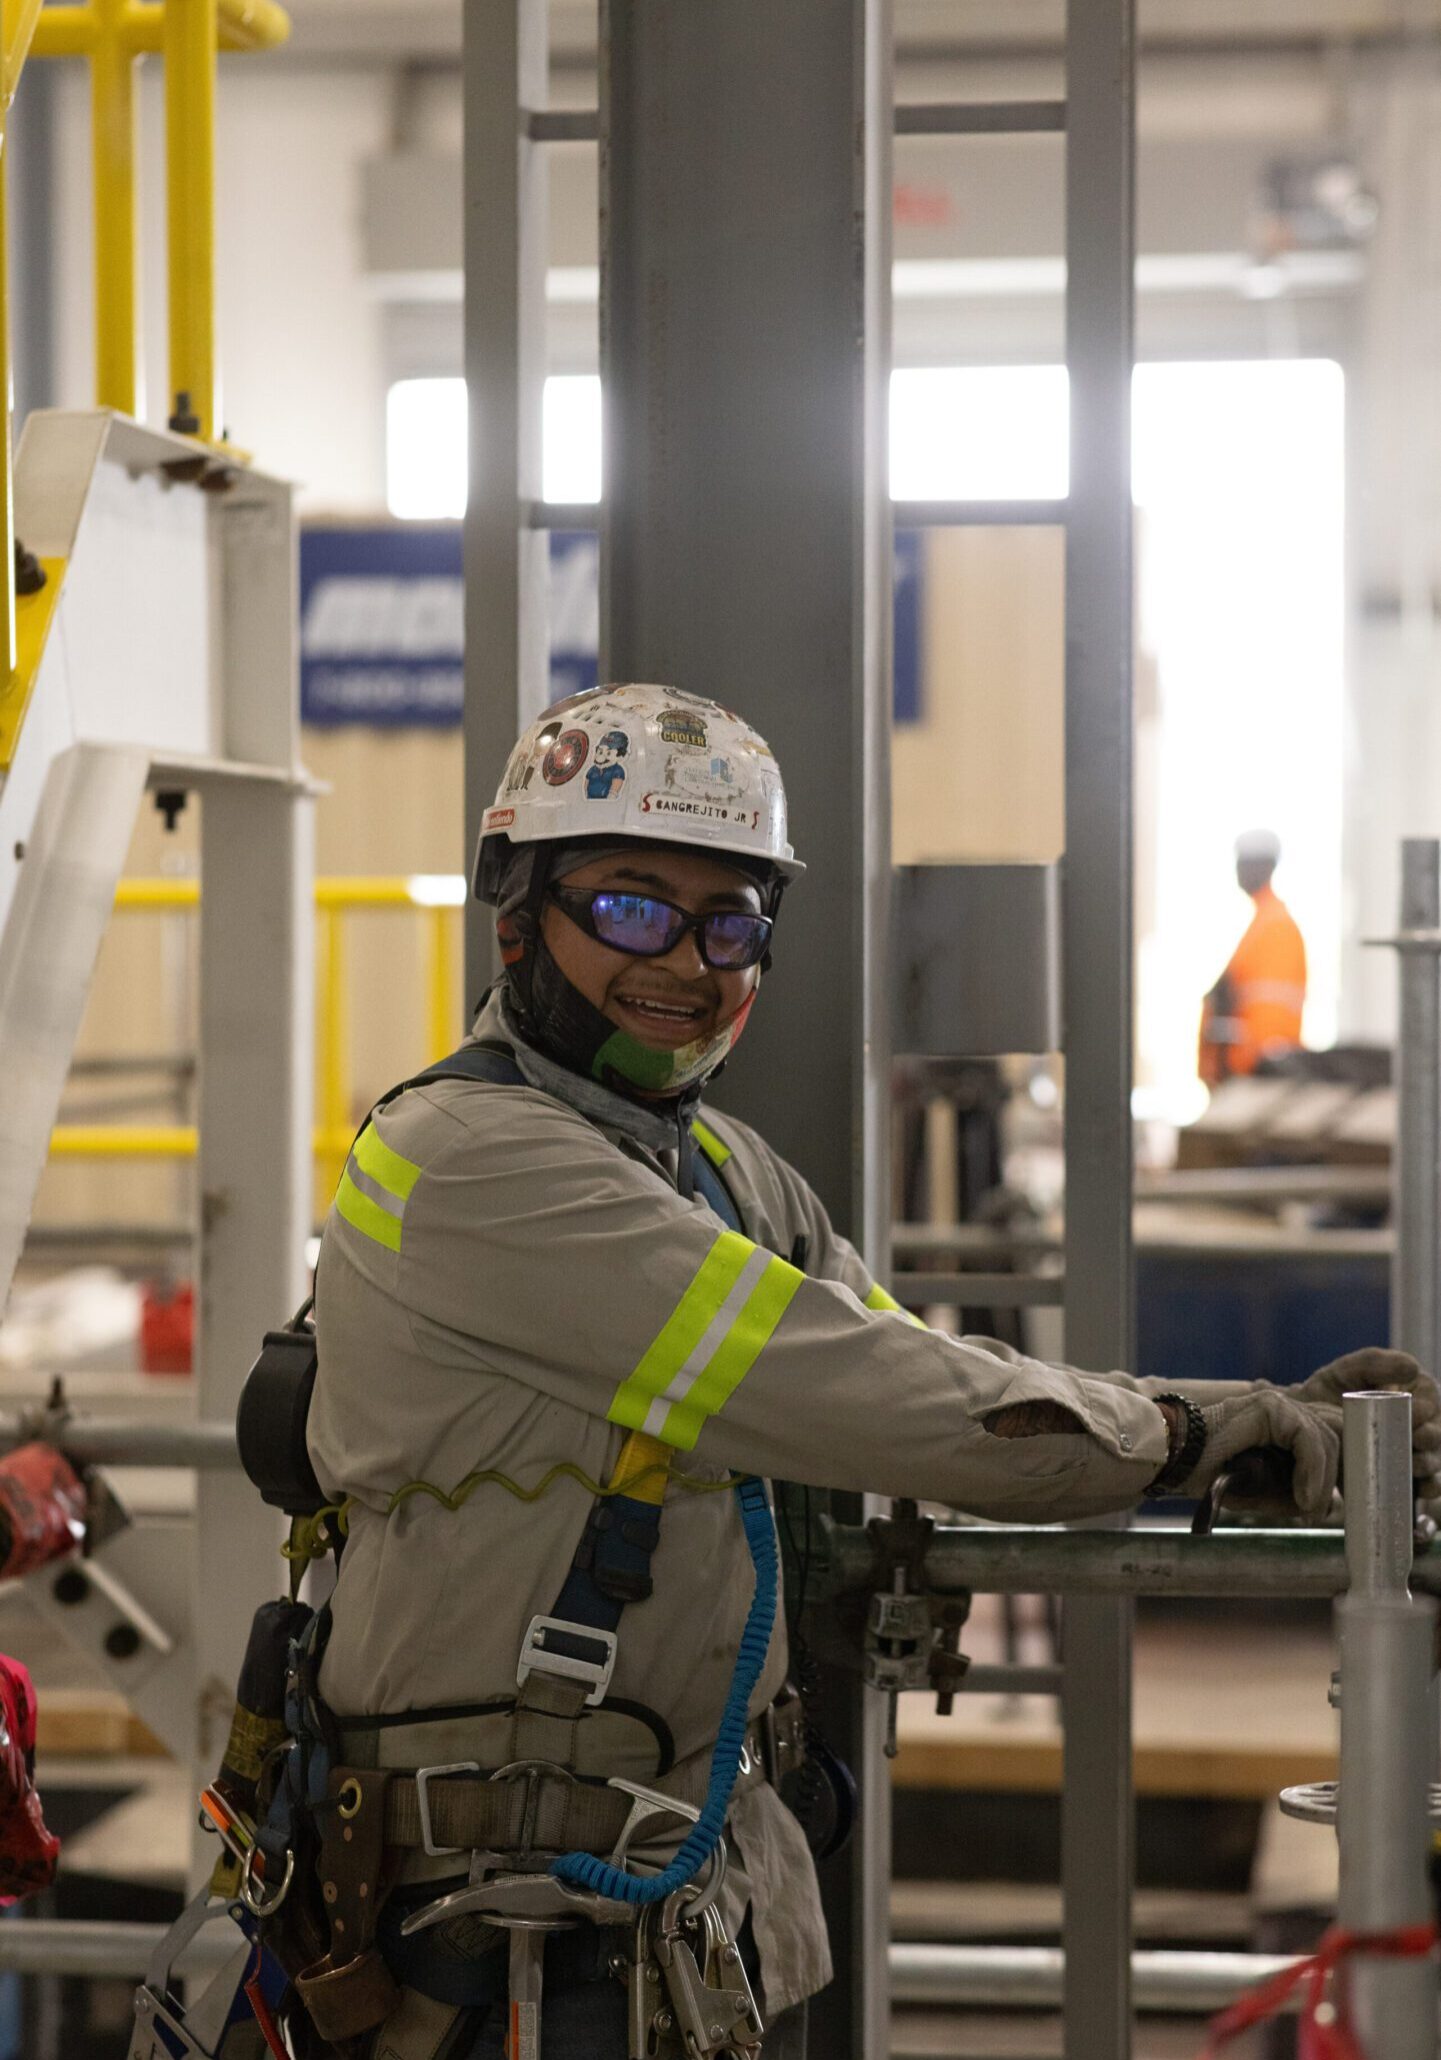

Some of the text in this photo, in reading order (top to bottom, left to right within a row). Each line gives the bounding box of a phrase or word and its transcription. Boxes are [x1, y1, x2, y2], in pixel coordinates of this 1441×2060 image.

[663, 732, 705, 746] COOLER
[656, 799, 728, 819] CANGREJITO
[734, 812, 746, 823] JR
